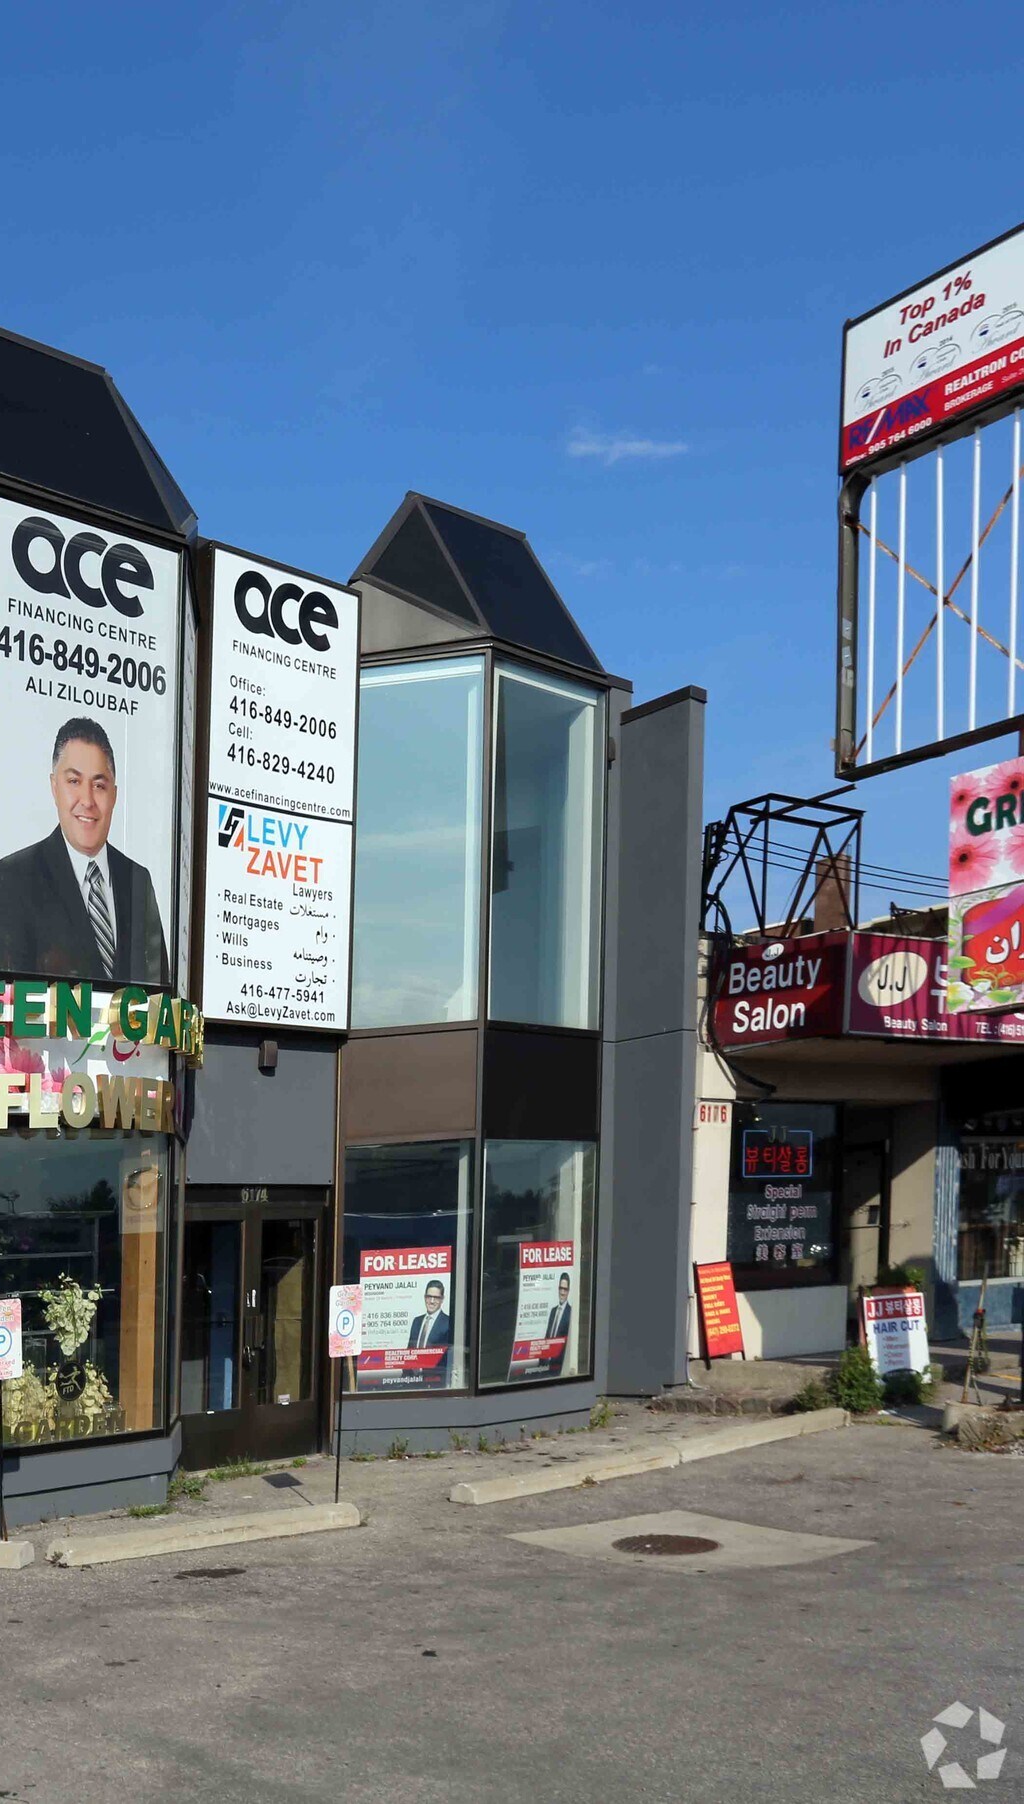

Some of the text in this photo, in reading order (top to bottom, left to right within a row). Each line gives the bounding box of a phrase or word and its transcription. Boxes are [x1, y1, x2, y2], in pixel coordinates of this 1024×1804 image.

[900, 271, 972, 325] Top 1%
[883, 338, 901, 358] In
[908, 293, 986, 344] Canada
[944, 354, 1007, 396] REALTRON
[944, 381, 994, 411] BROKERAGE
[868, 440, 886, 454] 905
[888, 430, 906, 444] 764
[908, 417, 932, 435] 6000
[11, 516, 155, 618] ace
[234, 570, 339, 652] ace
[8, 597, 157, 651] FINANCING CENTRE
[233, 640, 337, 680] FINANCING CENTRE
[25, 676, 139, 716] ALI ZILOUBAF
[230, 674, 266, 697] Office:
[230, 695, 337, 740] 416-849-2006
[228, 722, 253, 741] Cell:
[227, 743, 335, 784] 416-829-4240
[209, 781, 351, 819] www.acefinancingcentre.com
[247, 814, 309, 850] LEVY
[246, 846, 323, 884] ZAVET
[223, 889, 284, 911] Real Estate
[292, 883, 333, 902] Lawyers
[222, 910, 280, 932] Mortgages
[222, 931, 249, 947] Wills
[221, 953, 273, 971] Business
[728, 955, 823, 995] Beauty
[877, 964, 907, 992] J.J
[240, 983, 325, 1003] 416-477-5941
[226, 1001, 336, 1022] Ask@LevyZavet.com
[732, 998, 806, 1034] Salon
[884, 1015, 948, 1032] Beauty Salon
[700, 1105, 727, 1124] 6176
[745, 1146, 808, 1173] 뷰티살롱
[765, 1184, 802, 1201] Special
[746, 1204, 818, 1222] Straight perm
[754, 1226, 806, 1241] Extension
[364, 1253, 447, 1272] FOR LEASE
[523, 1247, 572, 1263] FOR LEASE
[364, 1281, 418, 1291] PEYVAND JALALI
[367, 1312, 379, 1320] 416
[868, 1301, 883, 1318] JJ
[342, 1316, 350, 1330] P
[367, 1320, 379, 1328] 905
[873, 1320, 919, 1334] HAIR CUT
[62, 1386, 75, 1396] FTD
[383, 1376, 423, 1385] peyvandjalali
